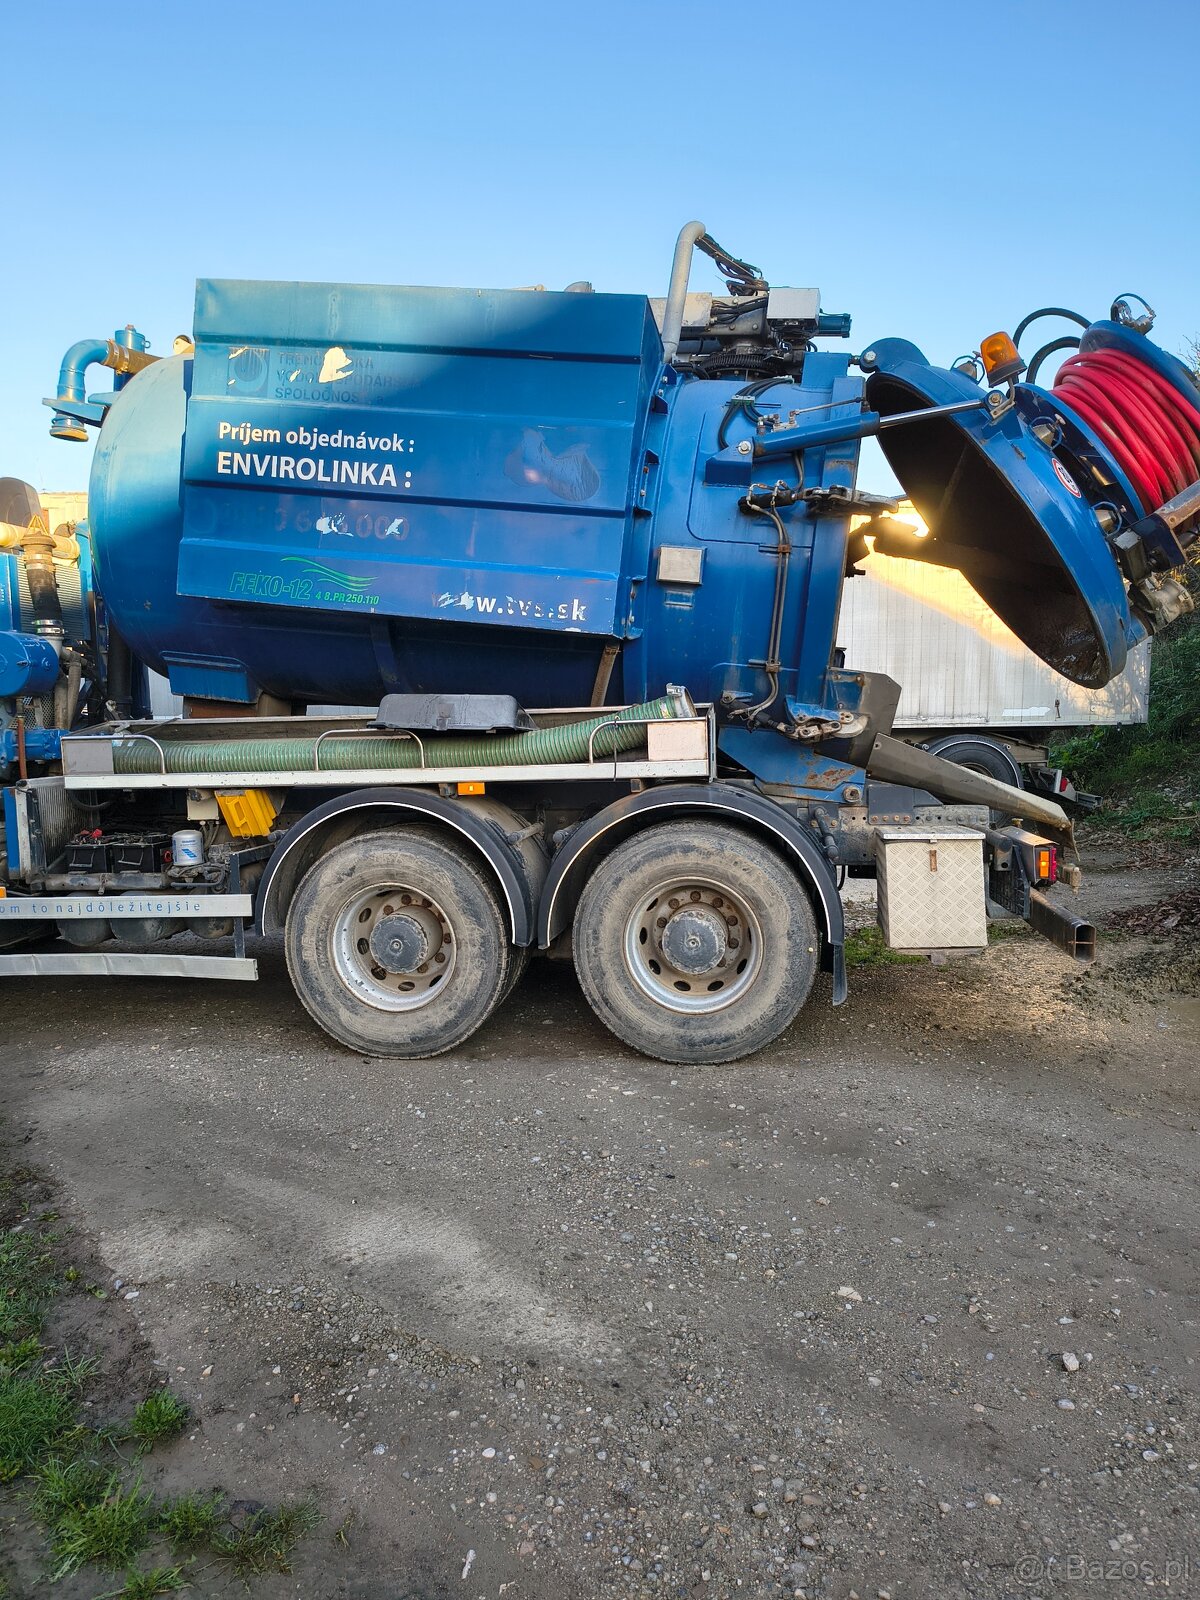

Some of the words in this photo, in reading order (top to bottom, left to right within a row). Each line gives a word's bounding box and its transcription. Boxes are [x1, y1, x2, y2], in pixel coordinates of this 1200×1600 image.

[219, 421, 281, 445] Príjem
[286, 427, 404, 452] objednávok
[217, 451, 397, 487] ENVIROLINKA
[229, 571, 313, 600] FEKO-12
[32, 903, 48, 913] to
